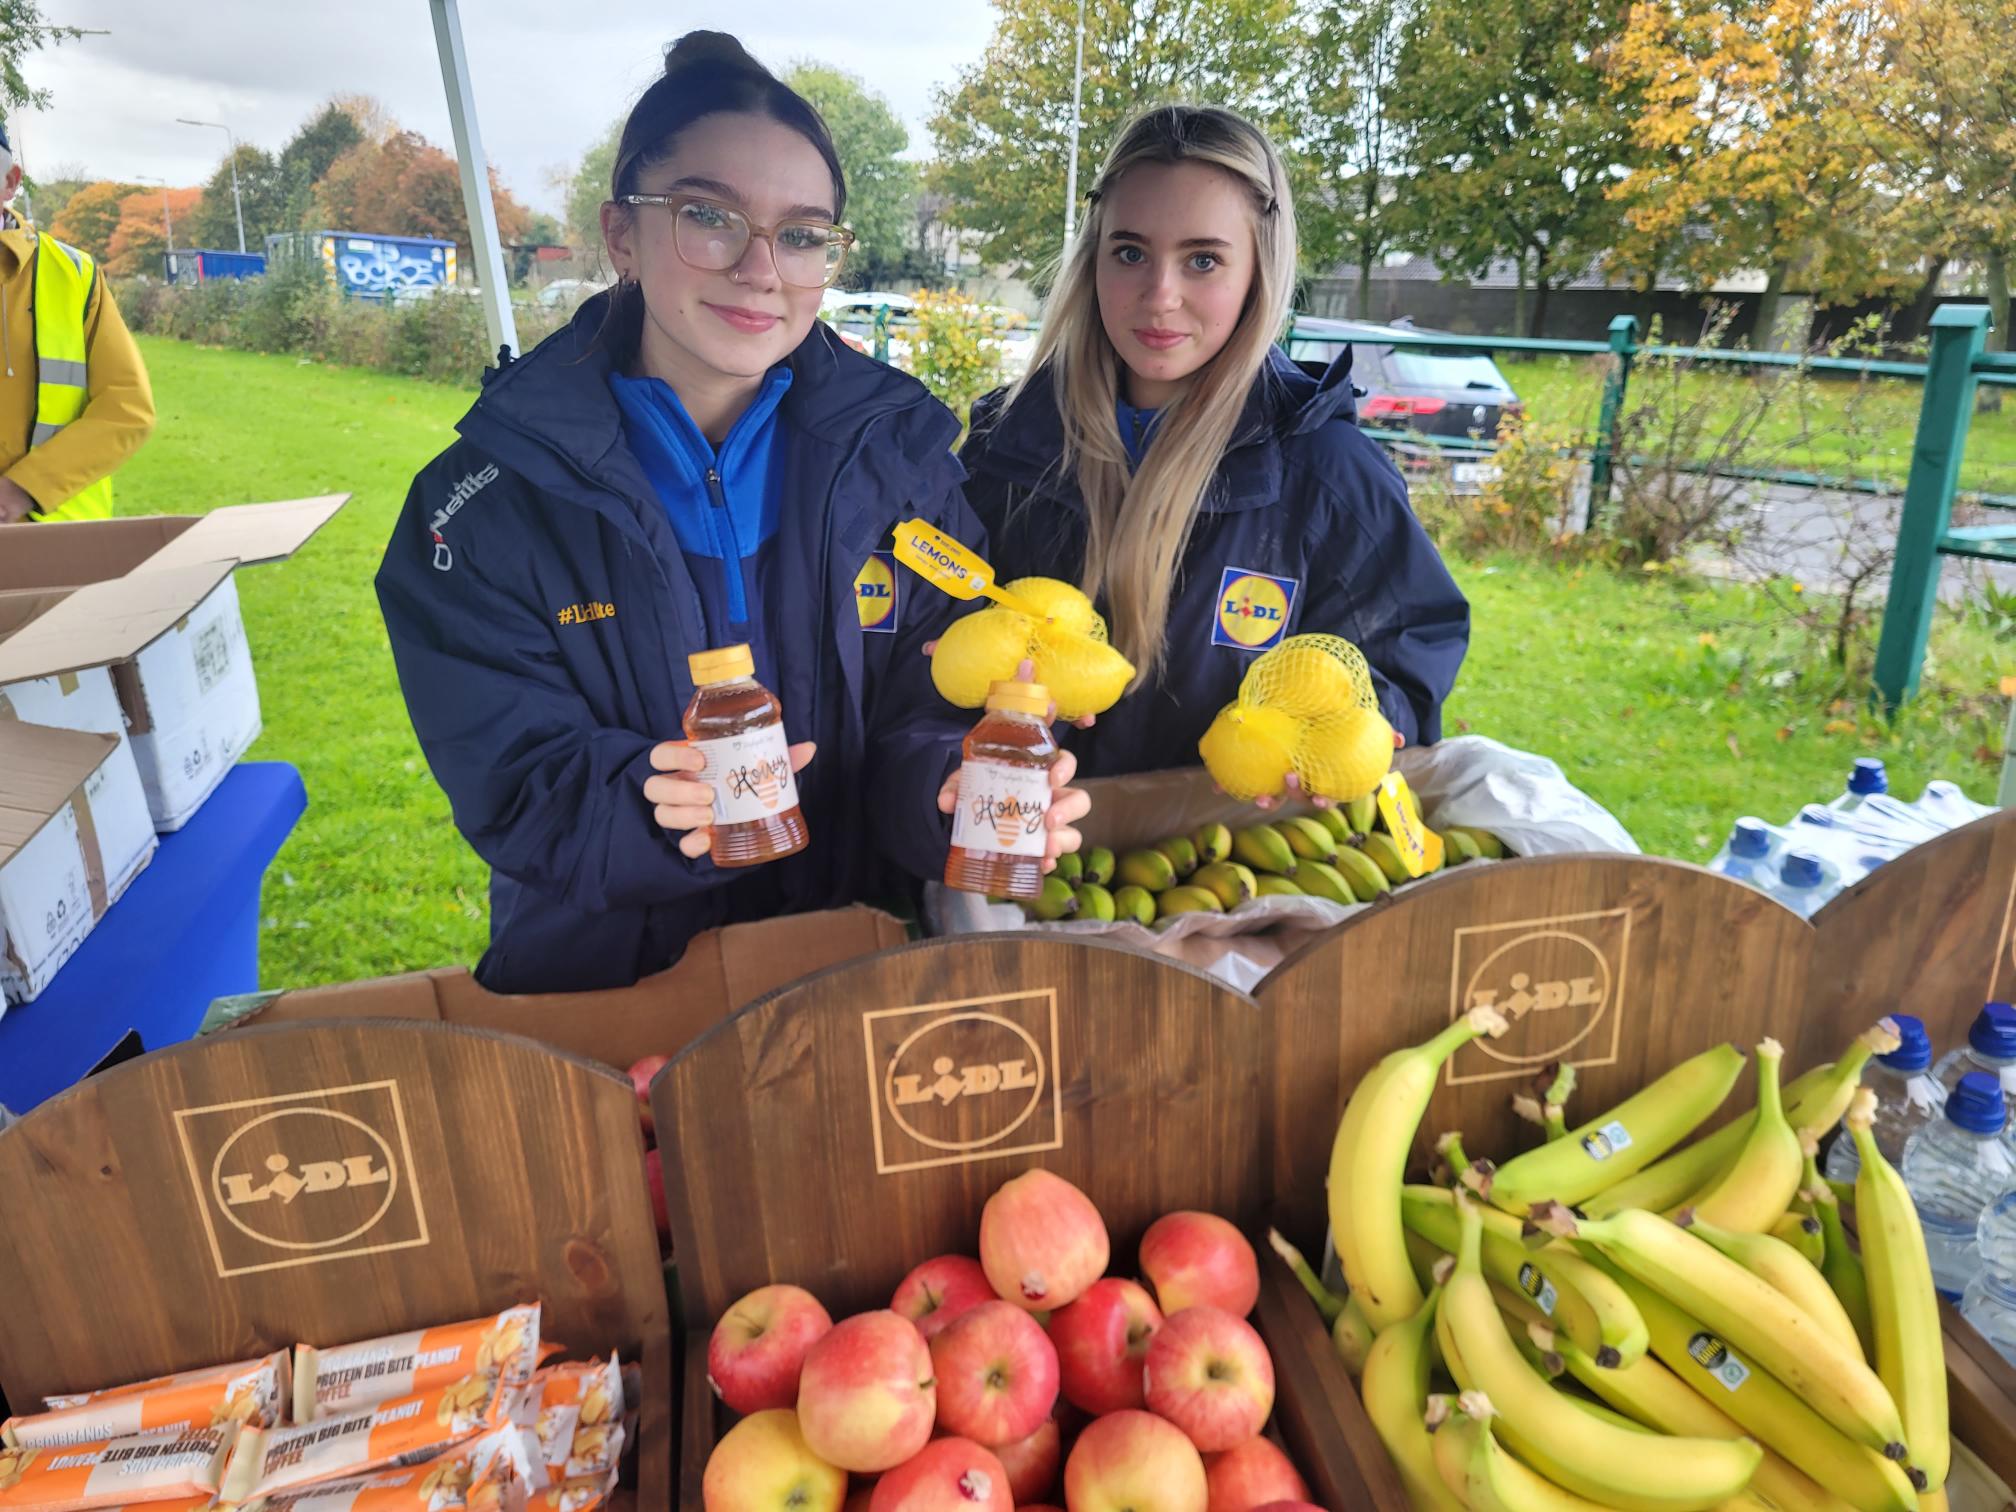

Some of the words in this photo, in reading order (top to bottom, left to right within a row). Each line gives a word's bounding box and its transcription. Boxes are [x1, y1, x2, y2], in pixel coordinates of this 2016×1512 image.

[911, 535, 968, 579] LEMONS
[729, 754, 787, 799] Honey
[974, 795, 1043, 834] Honey
[316, 1365, 363, 1386] PROTEIN
[364, 1361, 385, 1379] BIG
[387, 1355, 414, 1374] BITE
[416, 1346, 462, 1366] PEANUT
[160, 1439, 220, 1456] PROTEIN
[266, 1429, 317, 1459] PROTEIN
[318, 1421, 341, 1442] BIG
[342, 1415, 371, 1434] BITE
[373, 1401, 424, 1425] PEANUT
[47, 1452, 105, 1471] PEANUT
[101, 1447, 135, 1463] BITE
[134, 1444, 161, 1460] BIG
